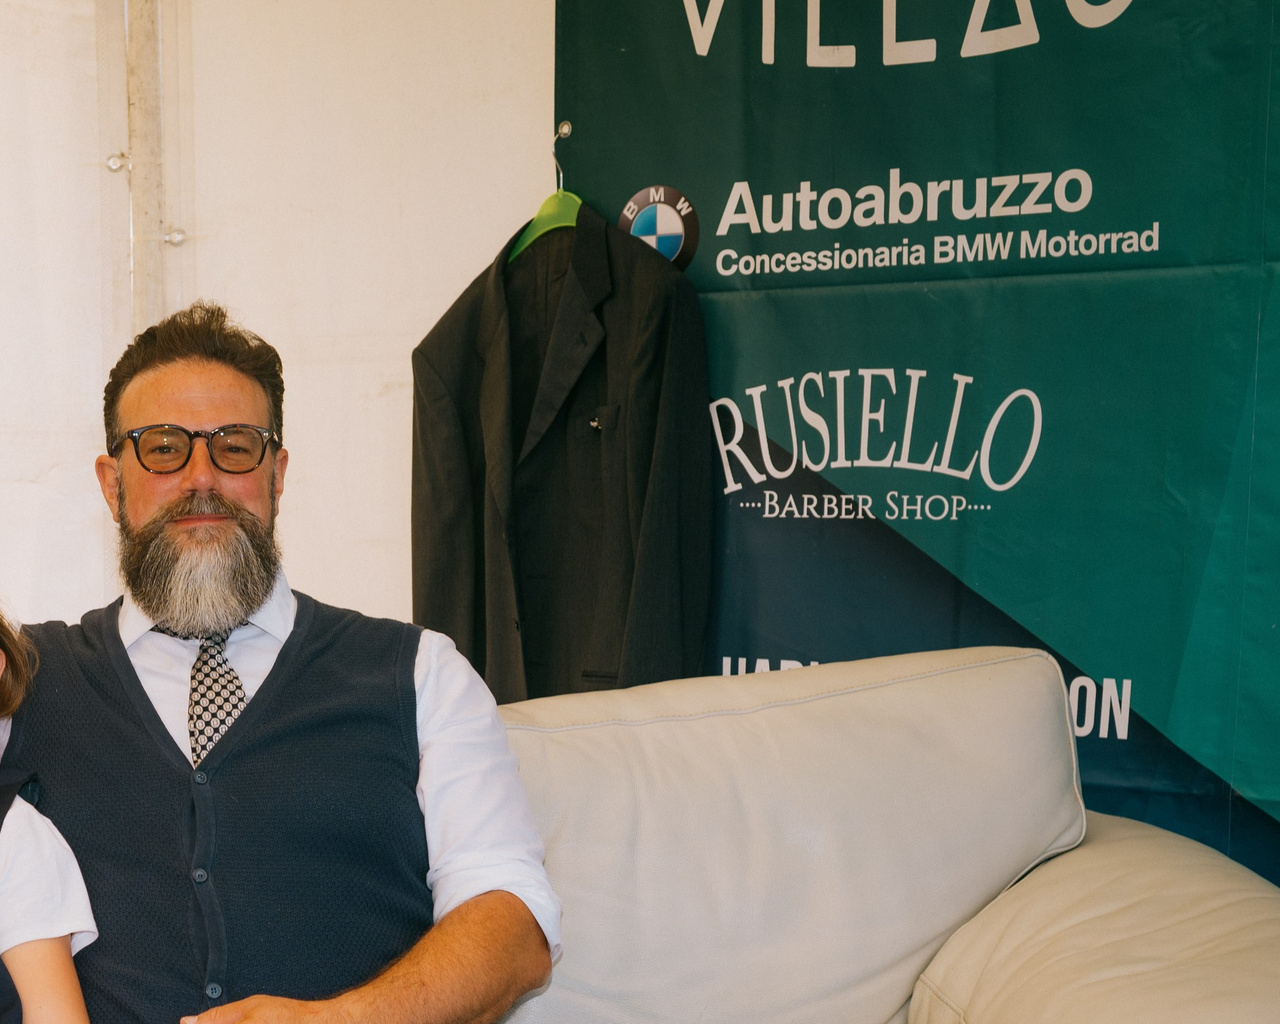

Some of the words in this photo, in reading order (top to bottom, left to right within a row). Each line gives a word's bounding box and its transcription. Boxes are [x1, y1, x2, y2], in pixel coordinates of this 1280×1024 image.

[623, 187, 693, 221] BMW
[715, 168, 1094, 236] Autoabruzzo
[715, 239, 925, 276] Concessionaria
[933, 231, 1014, 264] BMW
[1019, 222, 1160, 259] Motorrad
[709, 367, 1043, 496] RUSIELLO
[762, 491, 876, 520] BARBER
[885, 492, 966, 521] SHOP
